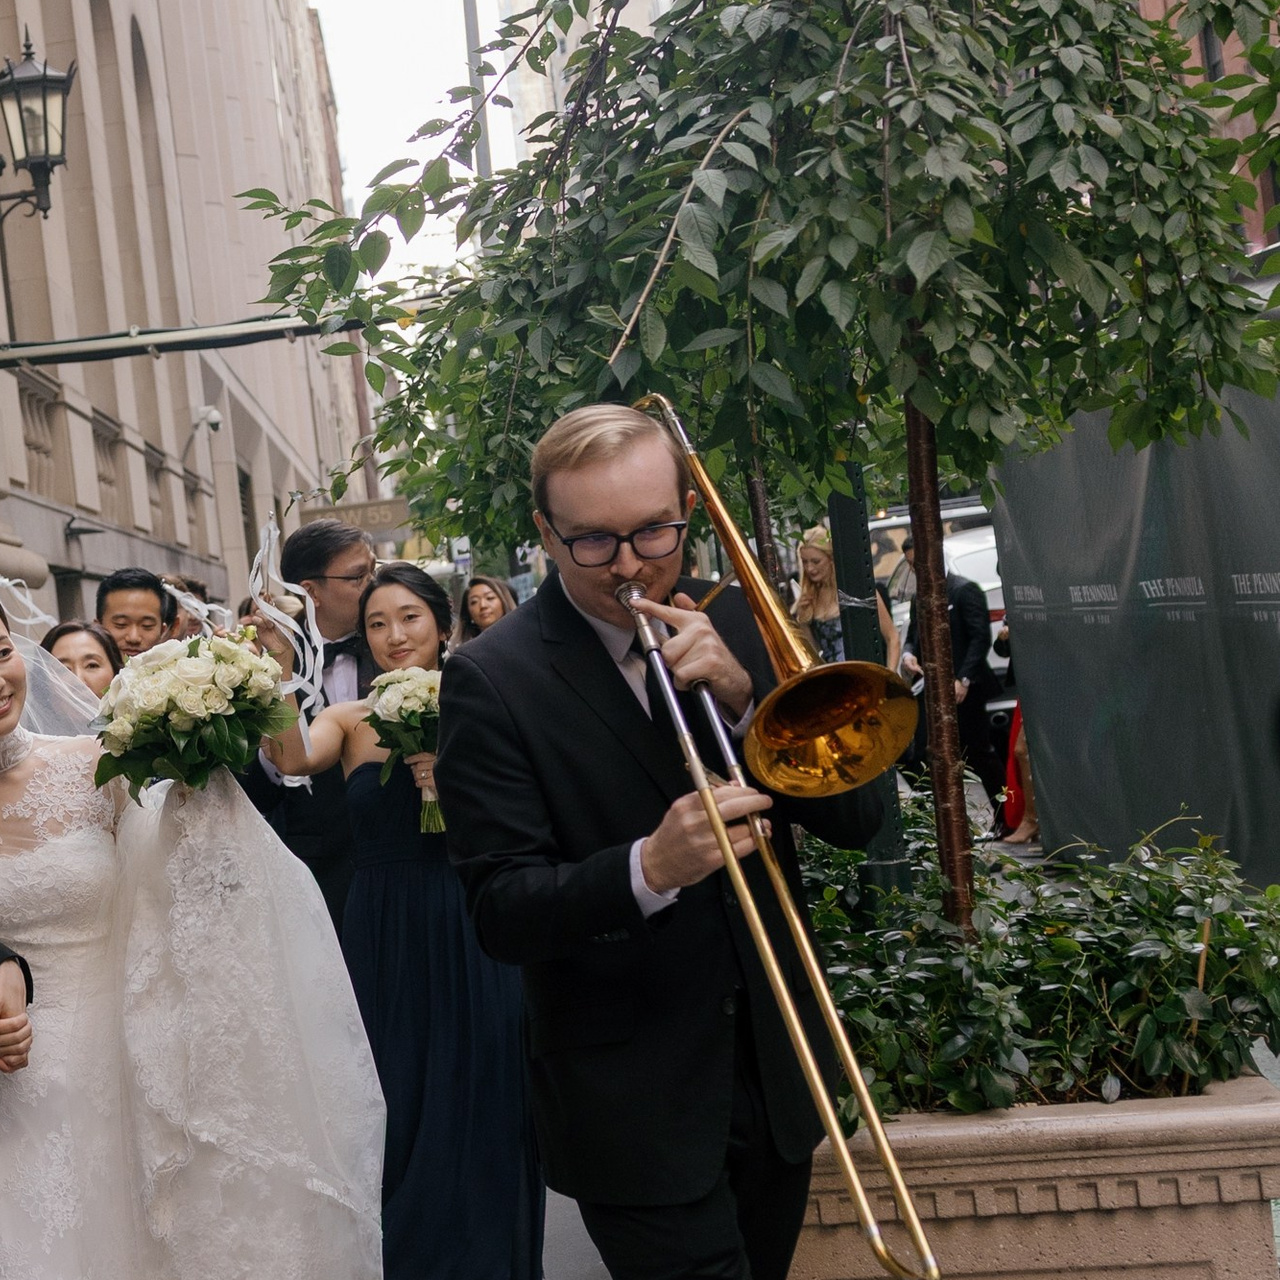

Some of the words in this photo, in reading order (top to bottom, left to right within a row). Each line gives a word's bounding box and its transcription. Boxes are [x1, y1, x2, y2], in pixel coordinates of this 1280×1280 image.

[1139, 578, 1166, 598] THE
[1231, 573, 1252, 594] THE
[1252, 572, 1280, 594] PENIN
